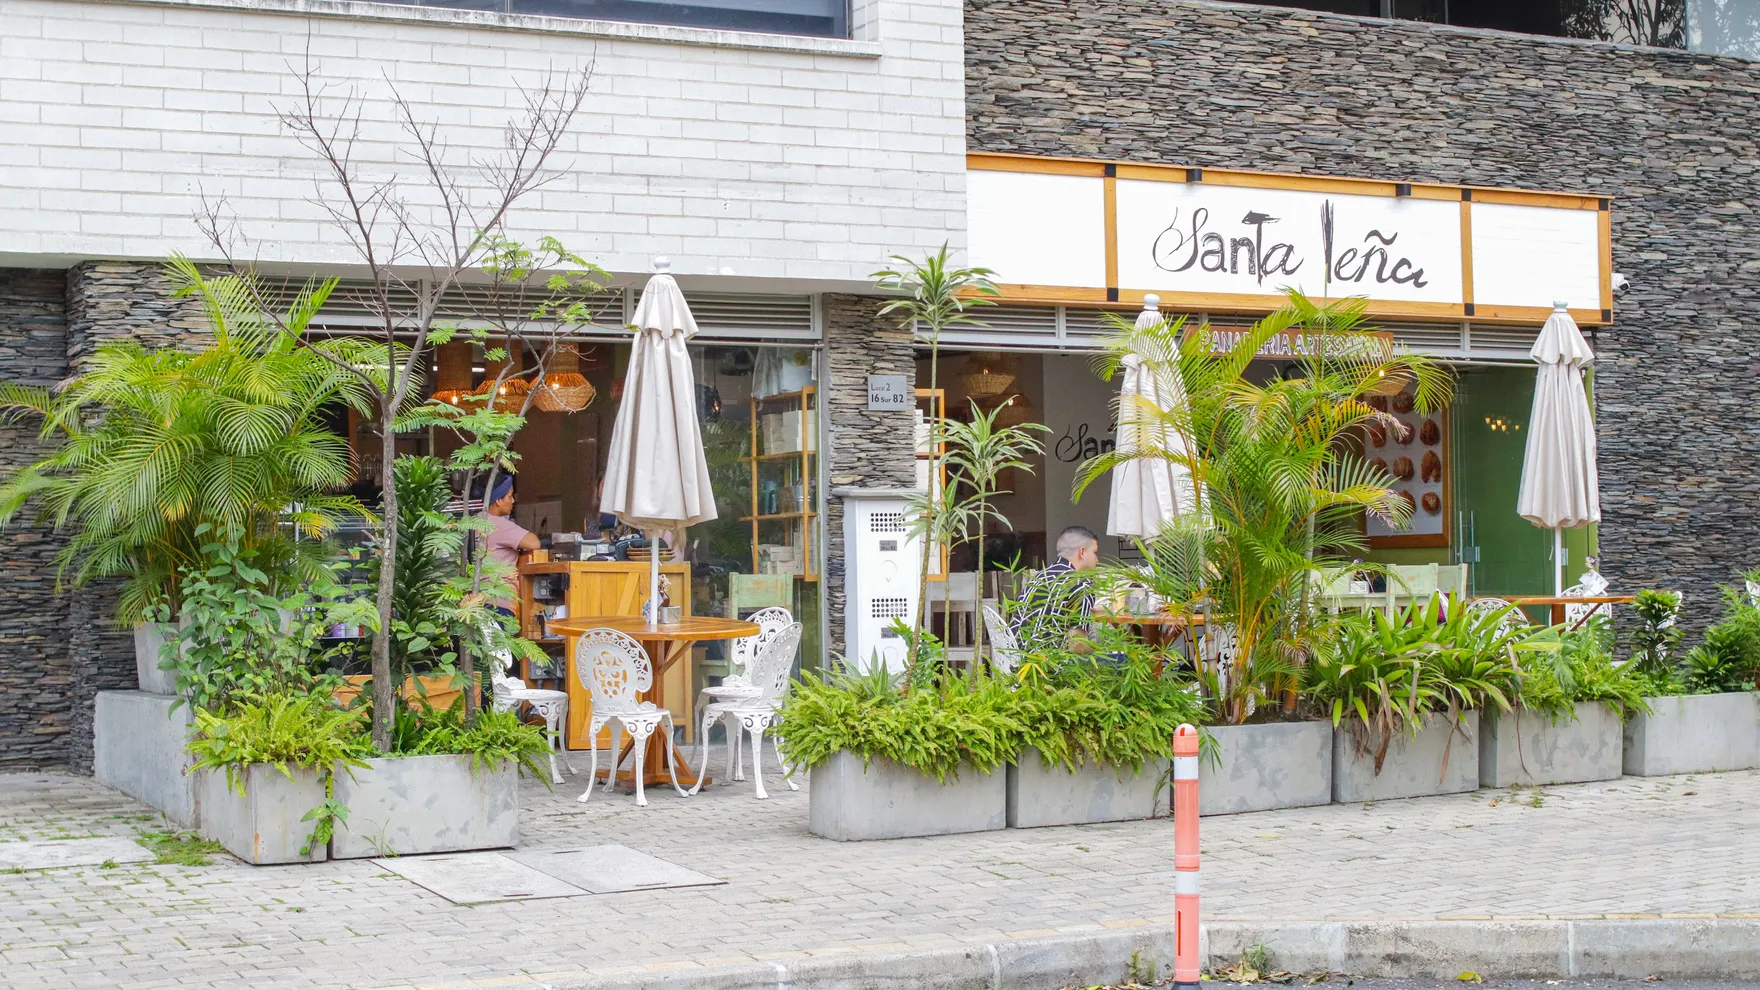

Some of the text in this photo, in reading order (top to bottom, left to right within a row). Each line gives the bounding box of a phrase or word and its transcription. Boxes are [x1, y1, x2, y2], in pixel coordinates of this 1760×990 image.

[1320, 199, 1428, 289] leña
[871, 383, 891, 391] Local 2
[871, 394, 880, 403] 16
[892, 394, 904, 403] 82
